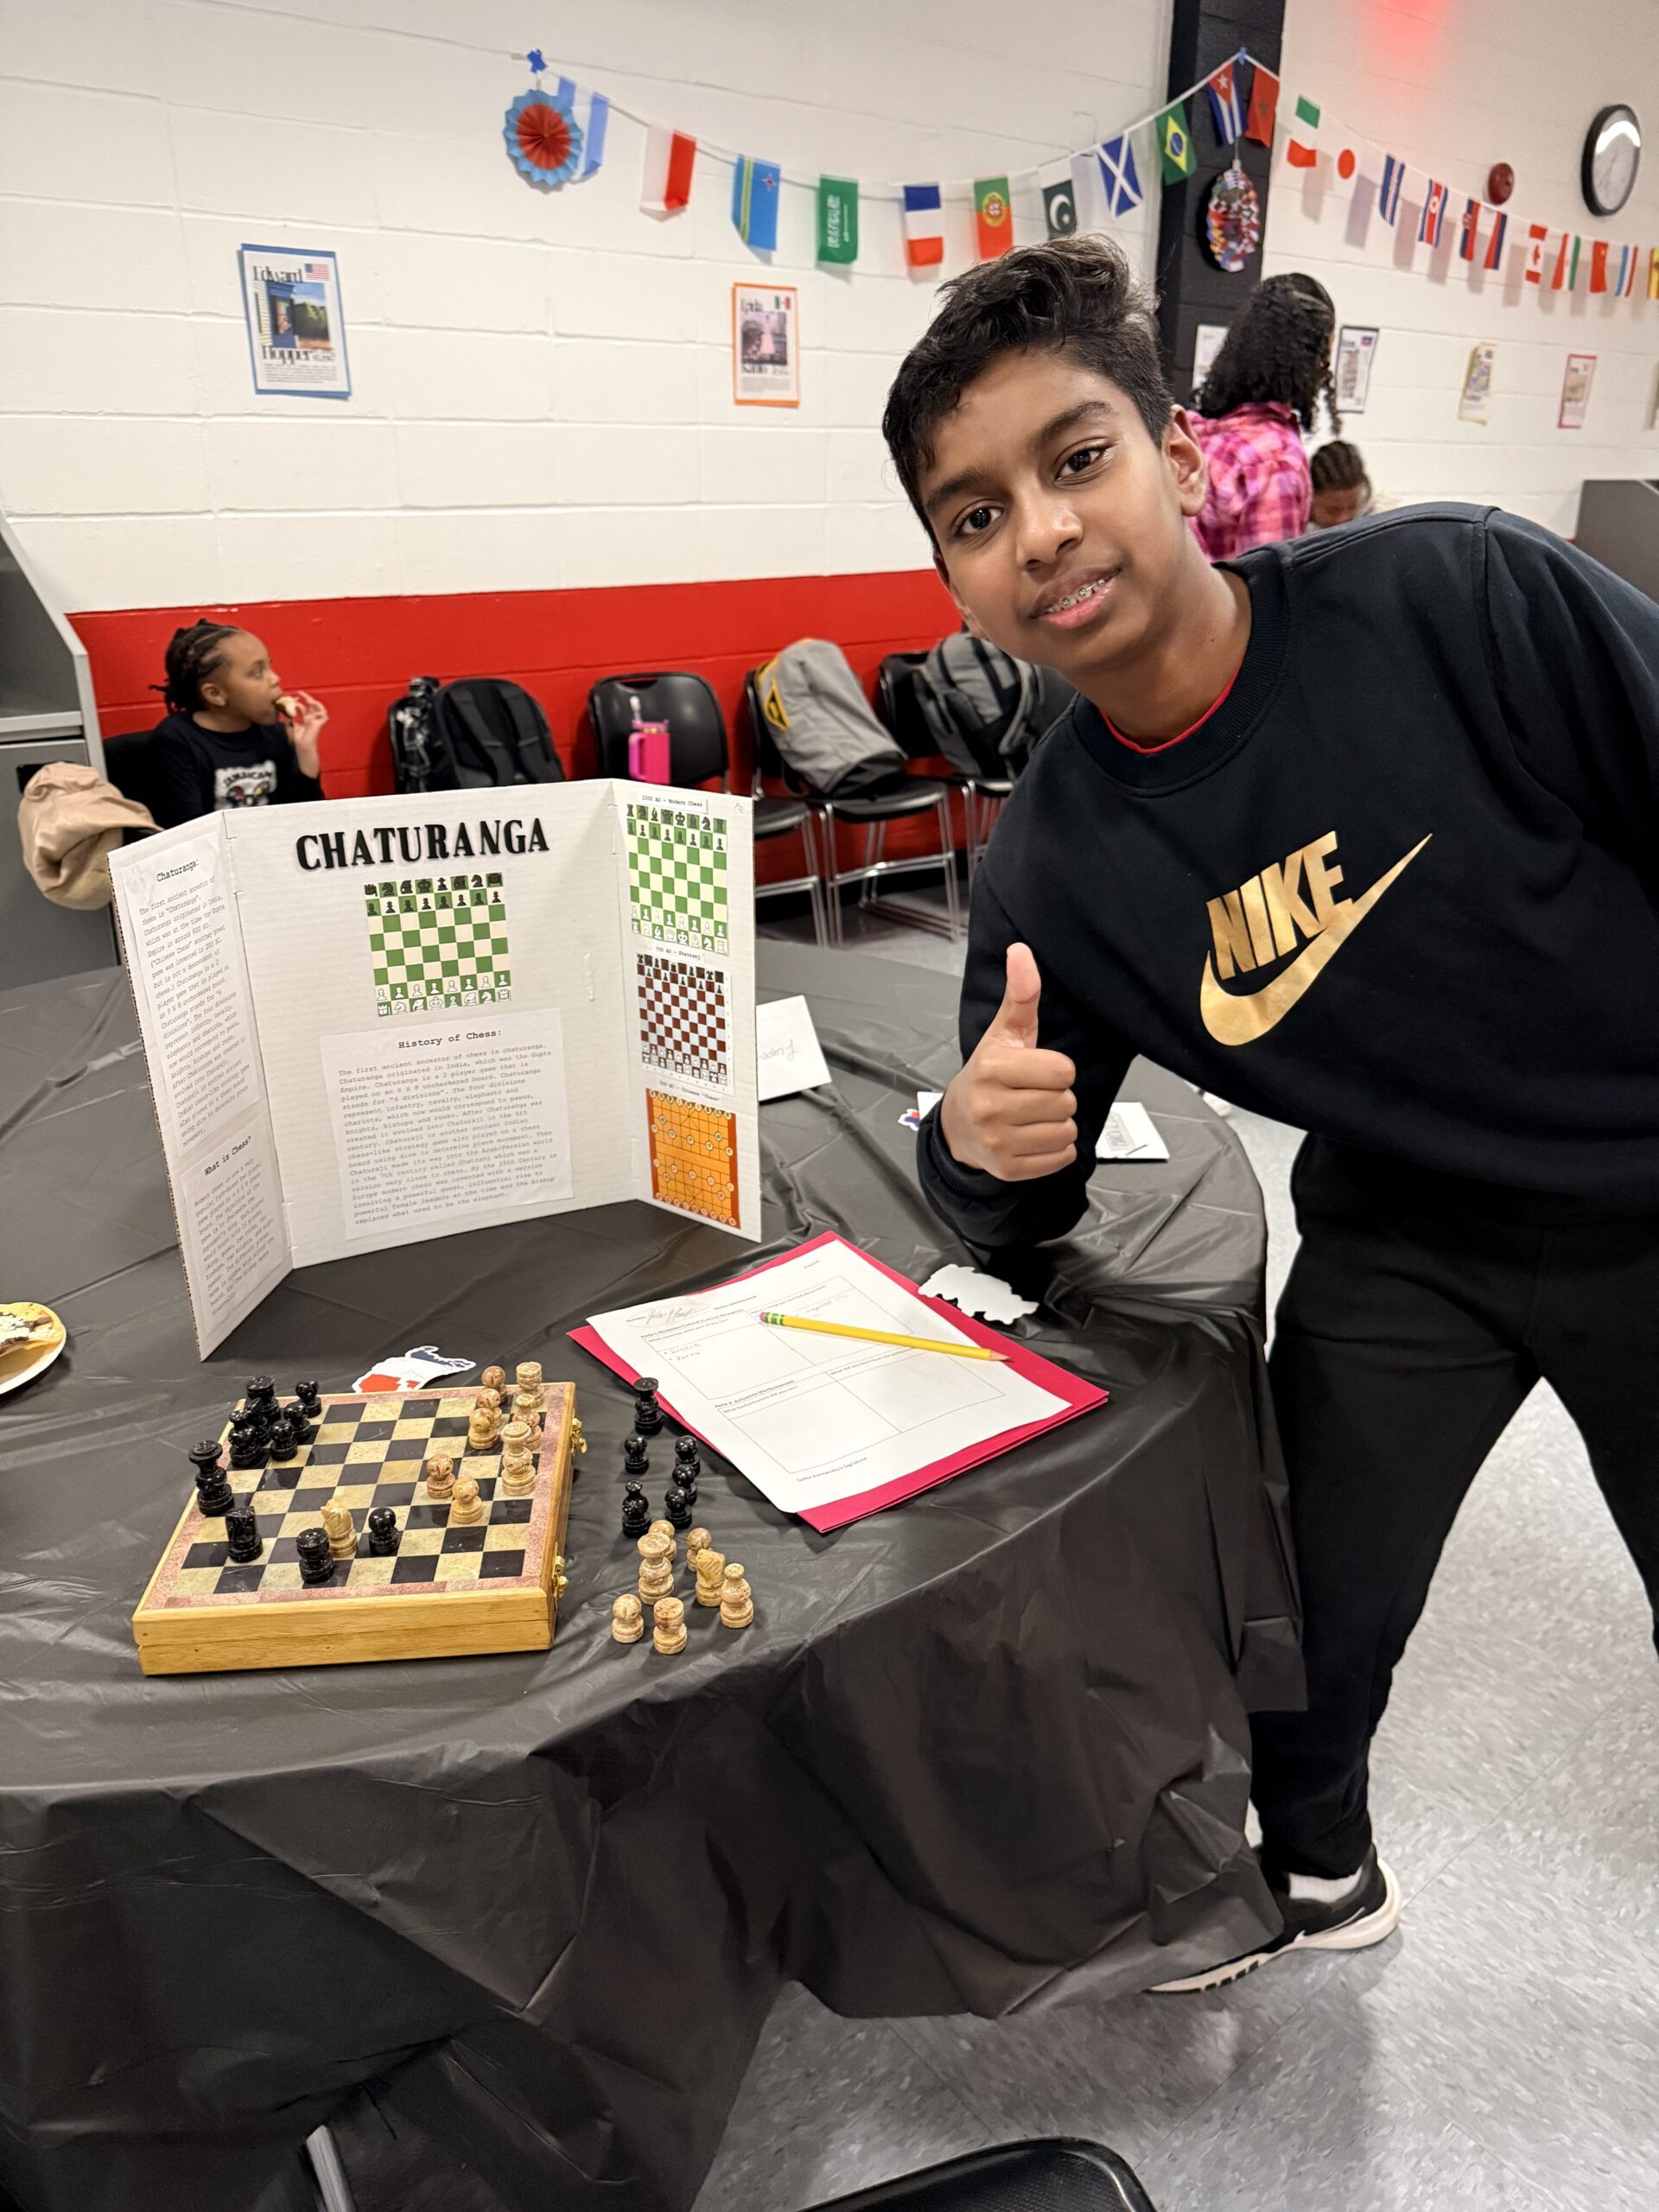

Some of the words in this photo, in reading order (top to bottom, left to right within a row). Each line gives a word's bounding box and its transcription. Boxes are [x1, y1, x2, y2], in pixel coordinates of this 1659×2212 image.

[252, 265, 303, 283] Edward
[296, 817, 550, 871] CHATURANGA
[156, 859, 200, 882] Chaturanga:
[1205, 830, 1354, 981] NIKE
[678, 951, 701, 960] Shatranj
[398, 1035, 442, 1049] History
[448, 1033, 460, 1043] of
[466, 1029, 502, 1039] Chess:
[340, 1075, 384, 1084] Chaturanga
[388, 1067, 430, 1077] originated
[383, 1060, 413, 1070] ancient
[341, 1092, 368, 1102] played
[423, 1078, 469, 1090] uncheckered
[501, 1070, 540, 1078] Chaturanga
[376, 1078, 418, 1088] Chaturanga
[681, 1087, 700, 1096] Chinese
[344, 1107, 383, 1117] represent
[387, 1103, 423, 1111] infantry,
[466, 1090, 502, 1100] elephants
[345, 1116, 383, 1126] chariots,
[454, 1099, 494, 1109] correspond
[346, 1126, 379, 1135] knights,
[487, 1103, 526, 1113] Chaturanga
[346, 1133, 377, 1142] created
[393, 1126, 423, 1135] evolved
[448, 1117, 484, 1127] Chaturaji
[348, 1148, 391, 1159] chess-like
[395, 1143, 429, 1152] strategy
[473, 1131, 497, 1141] played
[385, 1135, 423, 1145] Chaturaji
[473, 1122, 500, 1131] ancient
[204, 1161, 220, 1176] What
[222, 1154, 230, 1163] is
[232, 1135, 251, 1155] Chess?
[349, 1159, 371, 1167] board
[433, 1145, 470, 1154] determine
[498, 1134, 531, 1143] movement.
